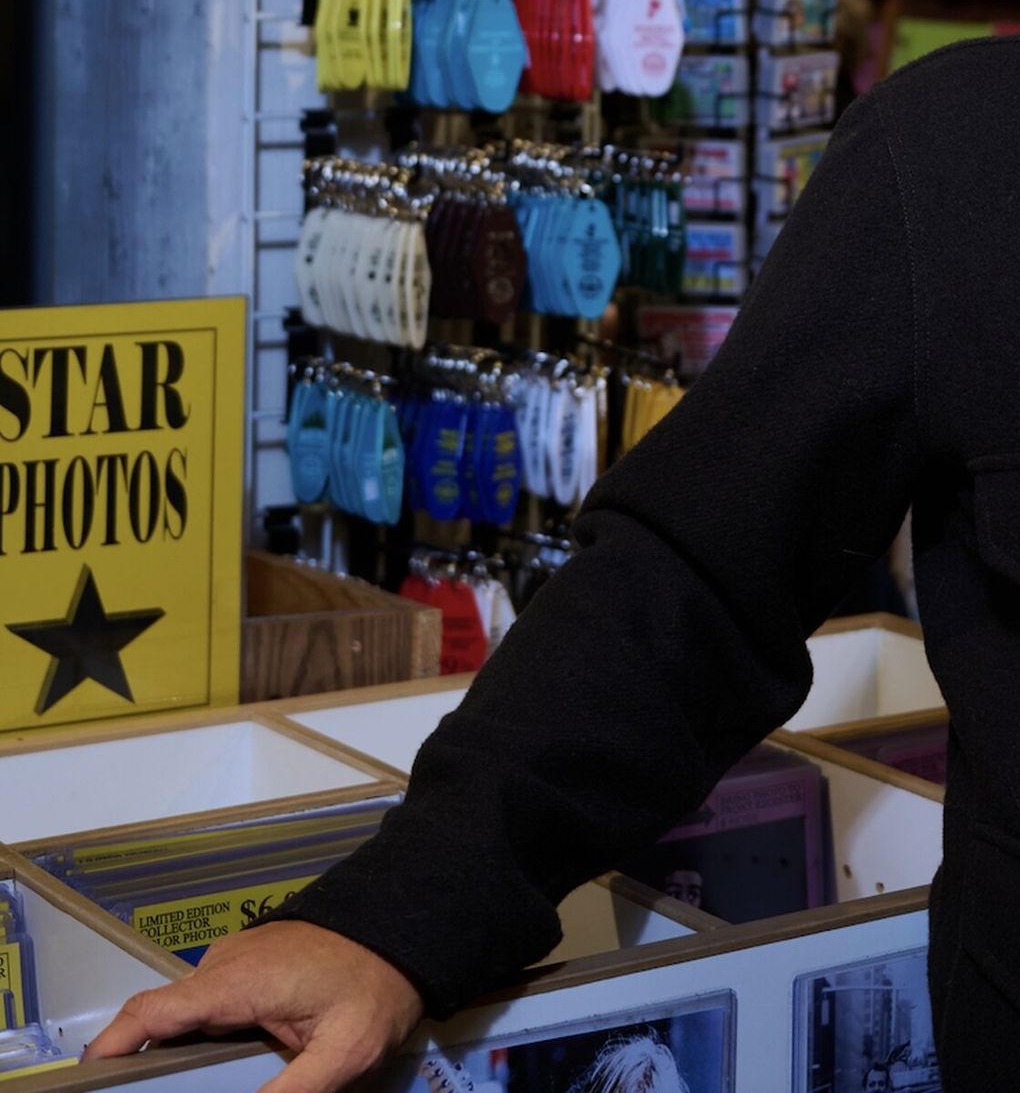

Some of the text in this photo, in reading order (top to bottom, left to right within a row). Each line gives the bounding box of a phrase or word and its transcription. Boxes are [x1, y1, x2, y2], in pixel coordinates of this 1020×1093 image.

[0, 340, 191, 442] STAR
[0, 448, 188, 555] PHOTOS
[139, 901, 230, 928] LIMITED EDITION
[140, 917, 210, 938] COLLECTOR
[183, 925, 229, 943] PHOTOS
